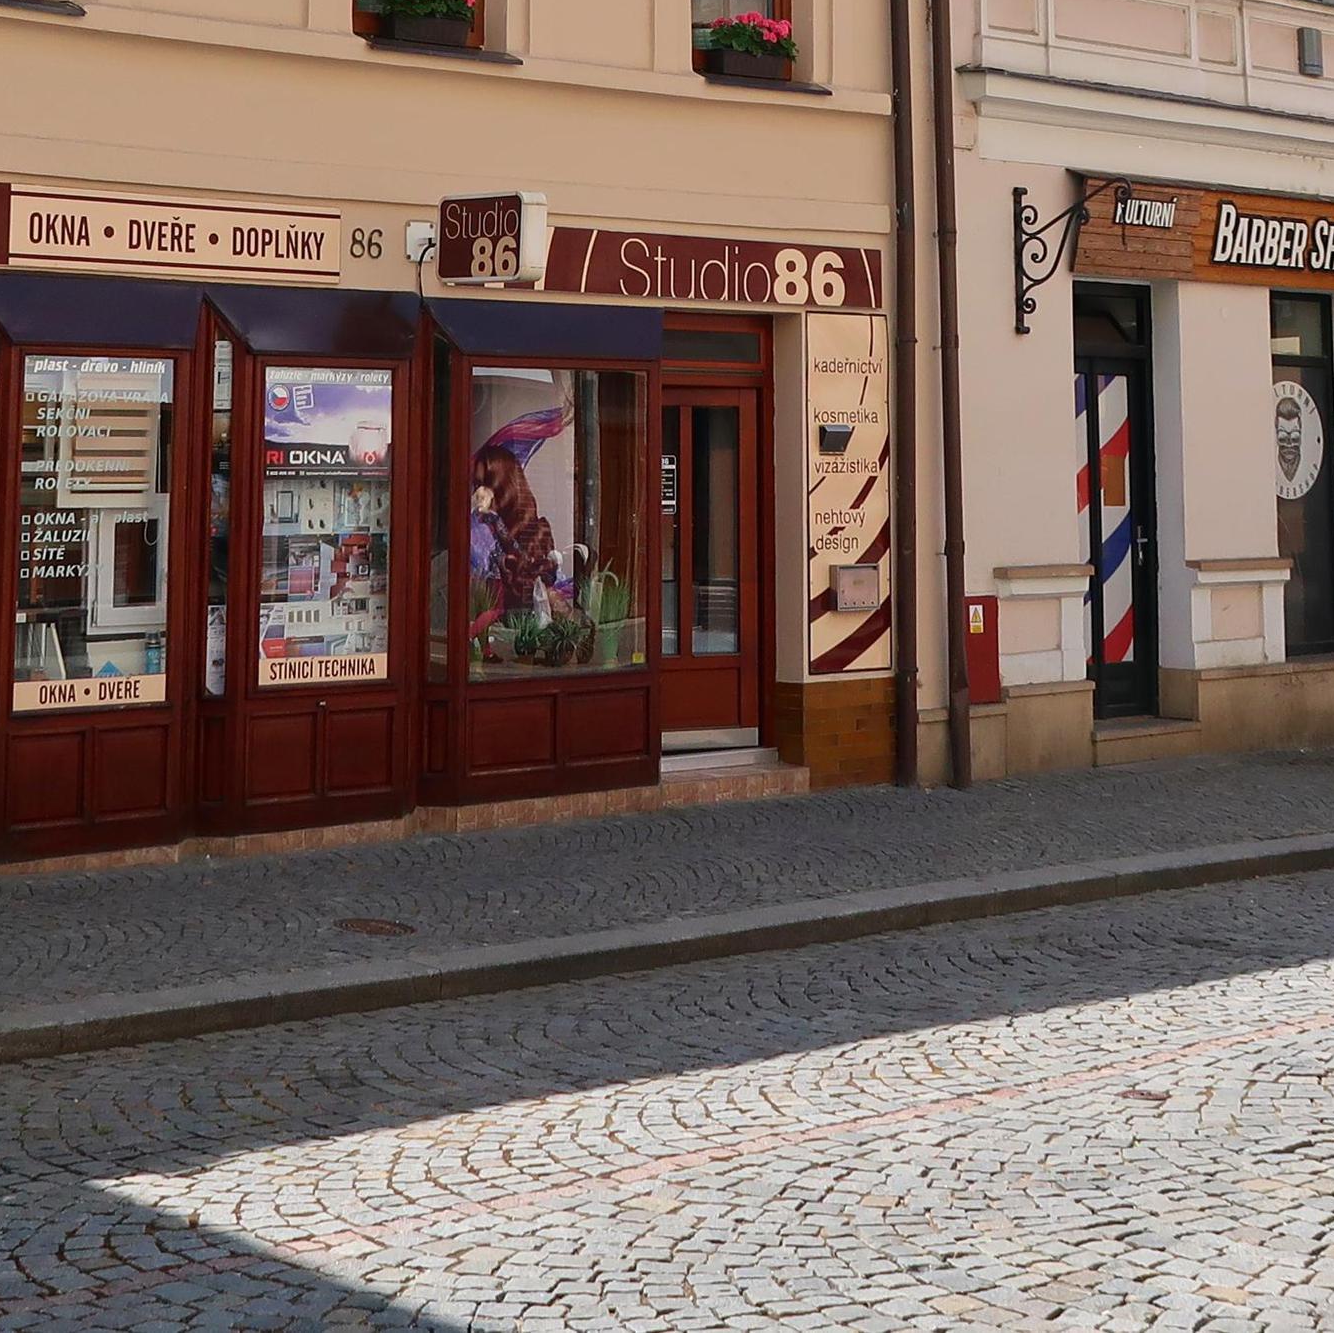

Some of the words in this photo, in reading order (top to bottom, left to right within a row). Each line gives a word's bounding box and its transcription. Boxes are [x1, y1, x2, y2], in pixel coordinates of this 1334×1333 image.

[445, 199, 520, 241] Studio
[28, 211, 91, 247] OKNA
[128, 216, 196, 253] DVEŘE
[232, 223, 325, 261] DOPLŇKY
[349, 227, 383, 260] 86
[1213, 204, 1309, 268] BARBER
[470, 234, 517, 279] 86
[34, 358, 69, 373] plast
[813, 357, 883, 374] kadeřnictví
[814, 407, 879, 424] kosmetika
[267, 450, 284, 465] RI
[289, 450, 345, 465] OKNA
[814, 457, 879, 474] vizážistika
[33, 512, 75, 525] OKNA
[815, 509, 866, 528] nehtový
[816, 534, 859, 555] design
[269, 657, 314, 682] STÍNICÍ
[318, 656, 376, 679] TECHNIKA
[39, 683, 76, 705] OKNA
[98, 678, 140, 702] DVEŘE
